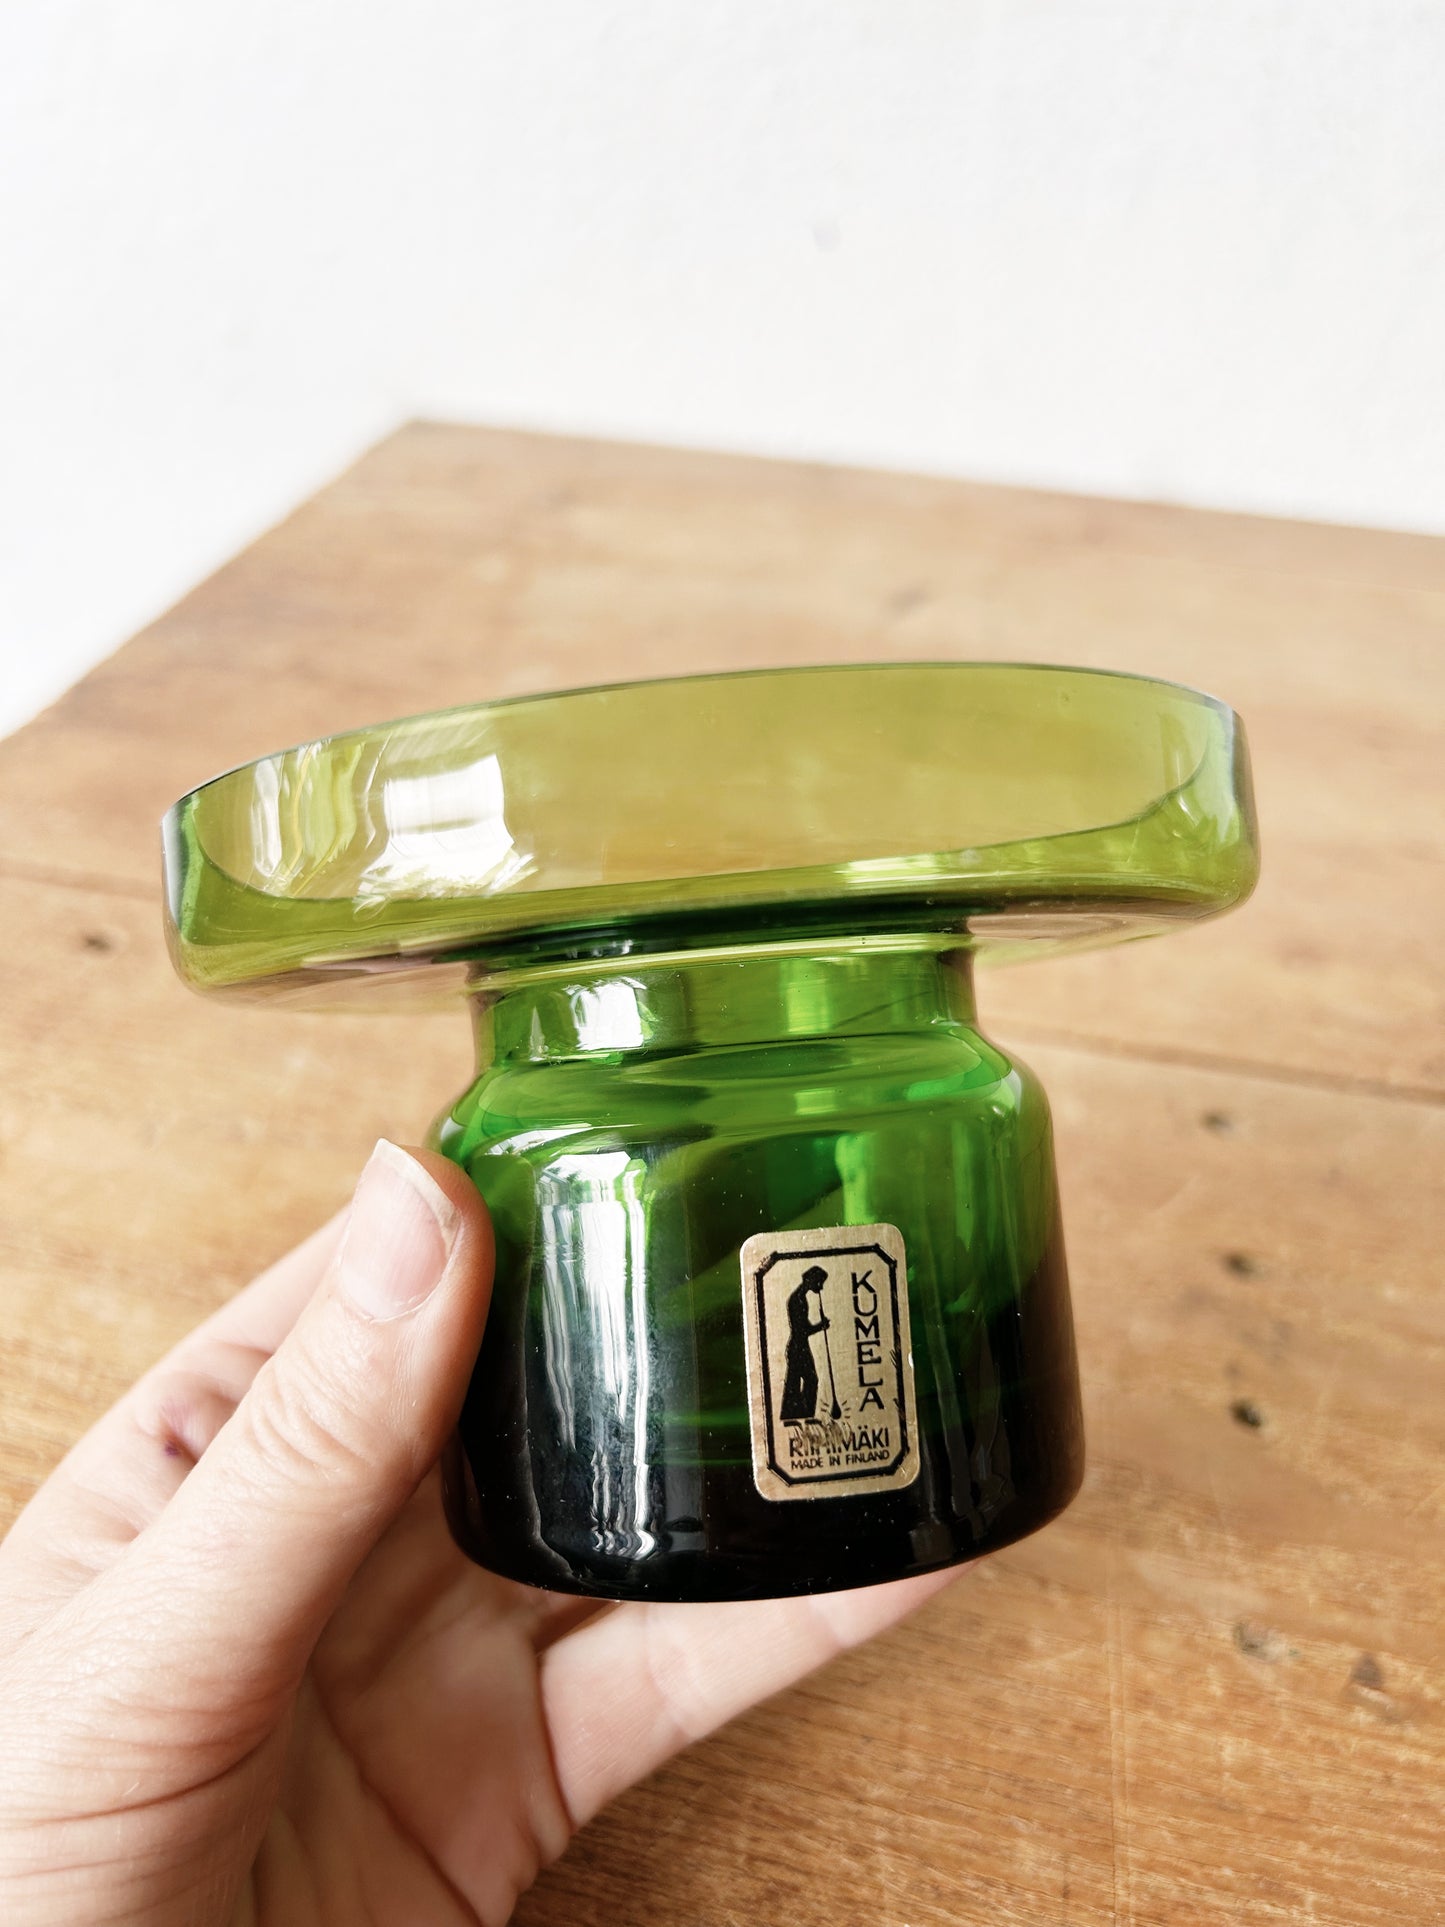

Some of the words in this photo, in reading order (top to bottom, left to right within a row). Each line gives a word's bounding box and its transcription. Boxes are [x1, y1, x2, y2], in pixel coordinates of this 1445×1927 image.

[851, 1270, 885, 1412] KUMELA
[790, 1457, 824, 1470] MADE
[829, 1455, 841, 1467] IN
[845, 1449, 890, 1465] FINLAND
